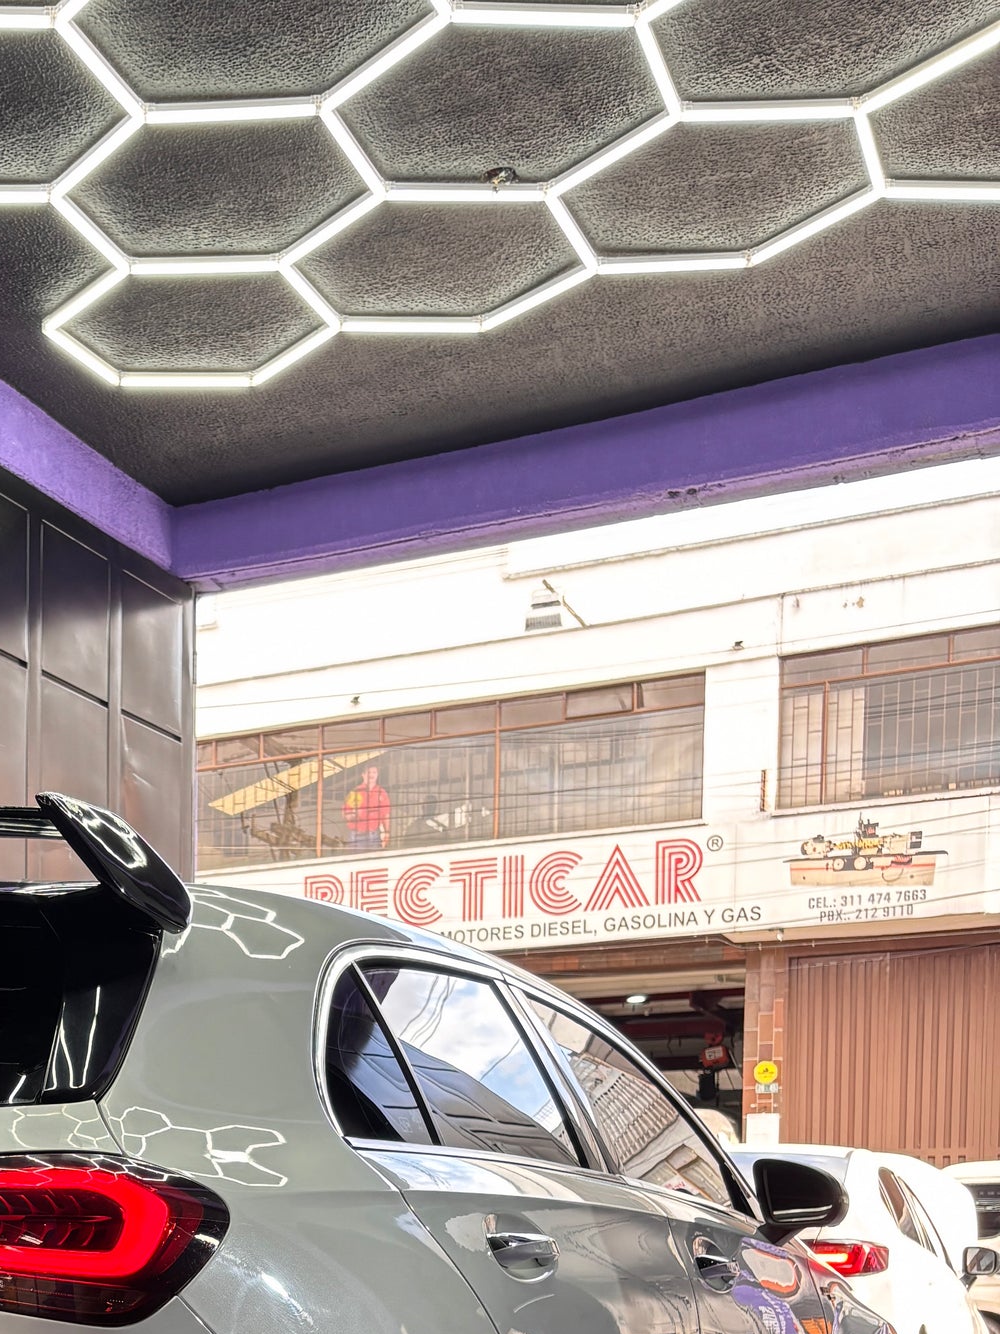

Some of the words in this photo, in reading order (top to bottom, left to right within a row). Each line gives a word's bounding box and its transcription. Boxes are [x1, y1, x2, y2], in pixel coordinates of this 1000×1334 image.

[840, 893, 863, 908] 311
[867, 891, 891, 905] 474
[895, 888, 927, 903] 7663
[530, 919, 597, 938] DIESEL,
[603, 911, 699, 932] GASOLINA
[703, 908, 716, 925] Y
[721, 905, 762, 923] GAS
[855, 907, 878, 920] 212
[882, 903, 914, 917] 9110
